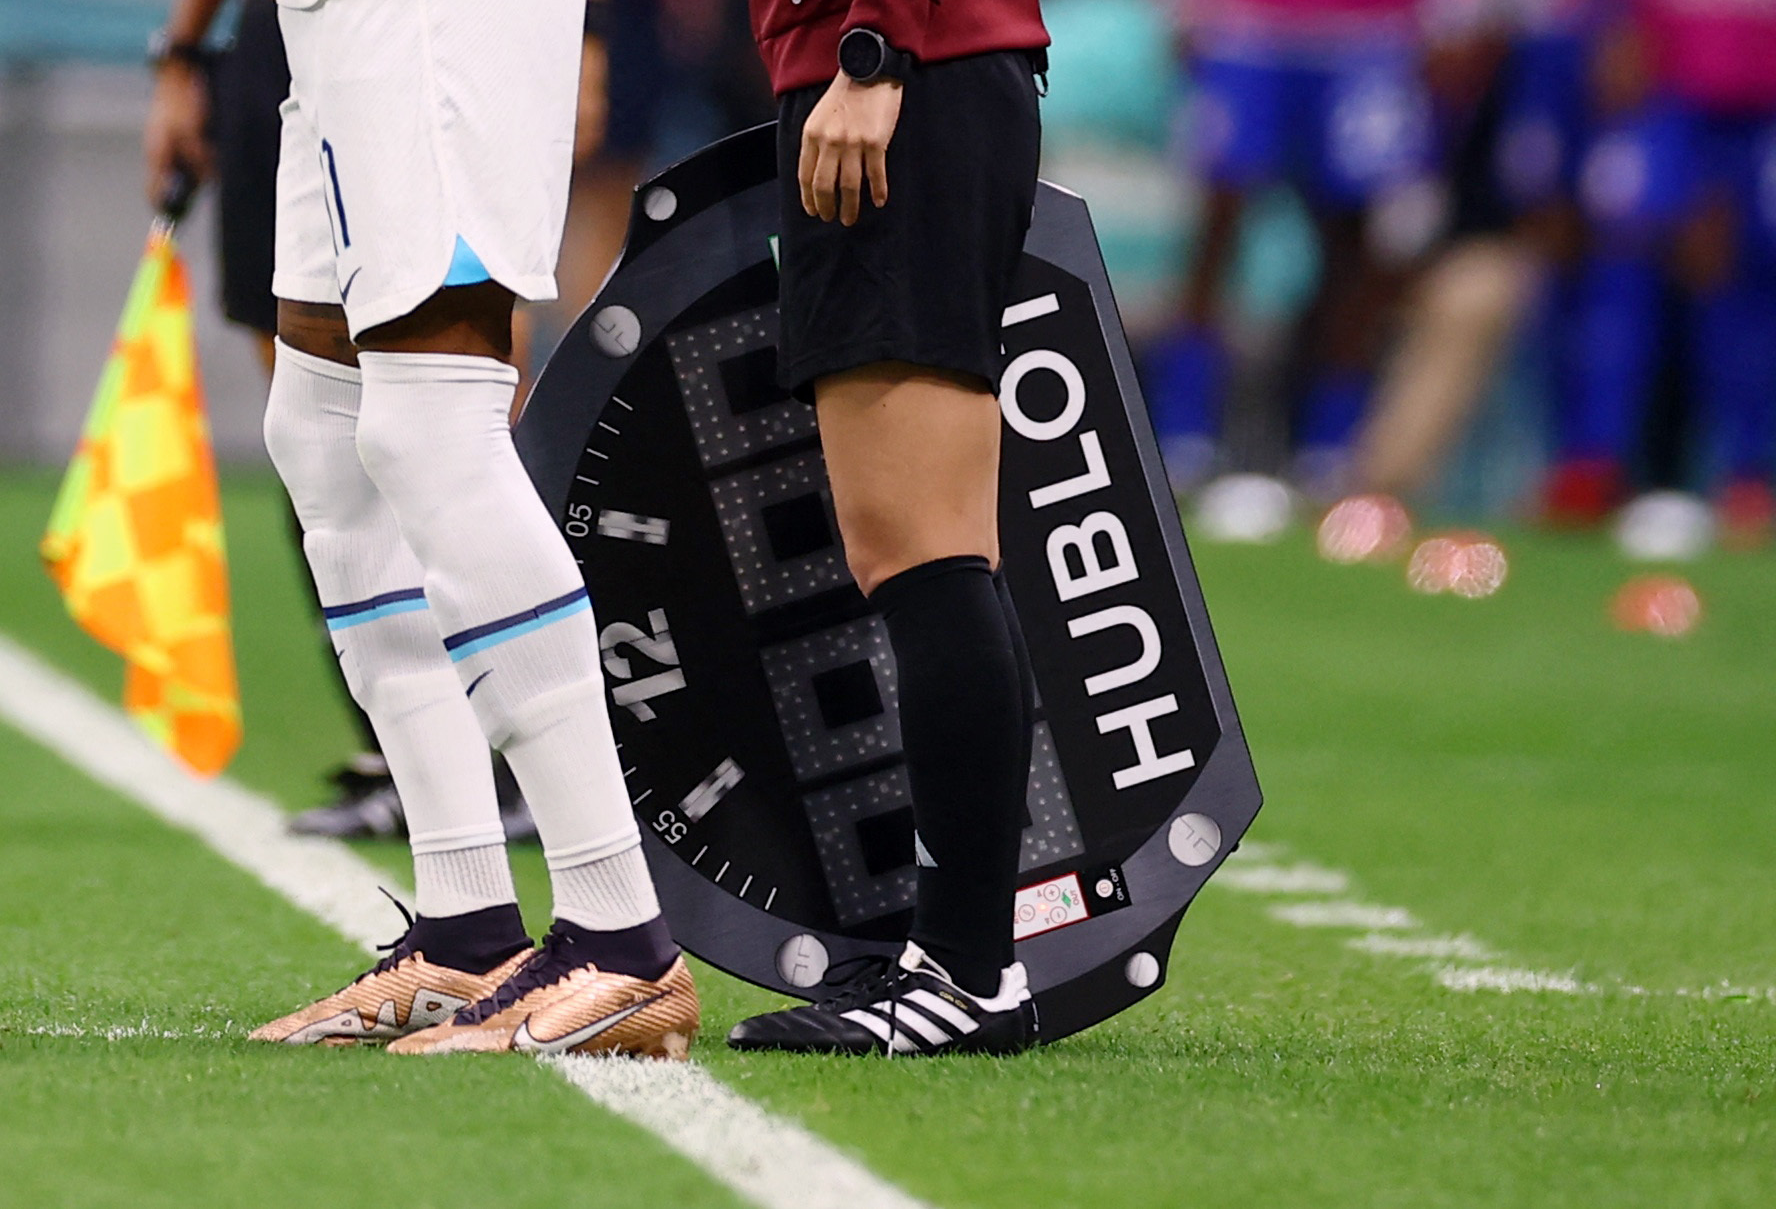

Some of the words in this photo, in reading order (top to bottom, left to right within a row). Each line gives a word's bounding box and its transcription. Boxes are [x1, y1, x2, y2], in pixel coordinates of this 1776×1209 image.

[565, 502, 593, 538] 05
[599, 607, 687, 723] 12
[652, 809, 688, 845] 55
